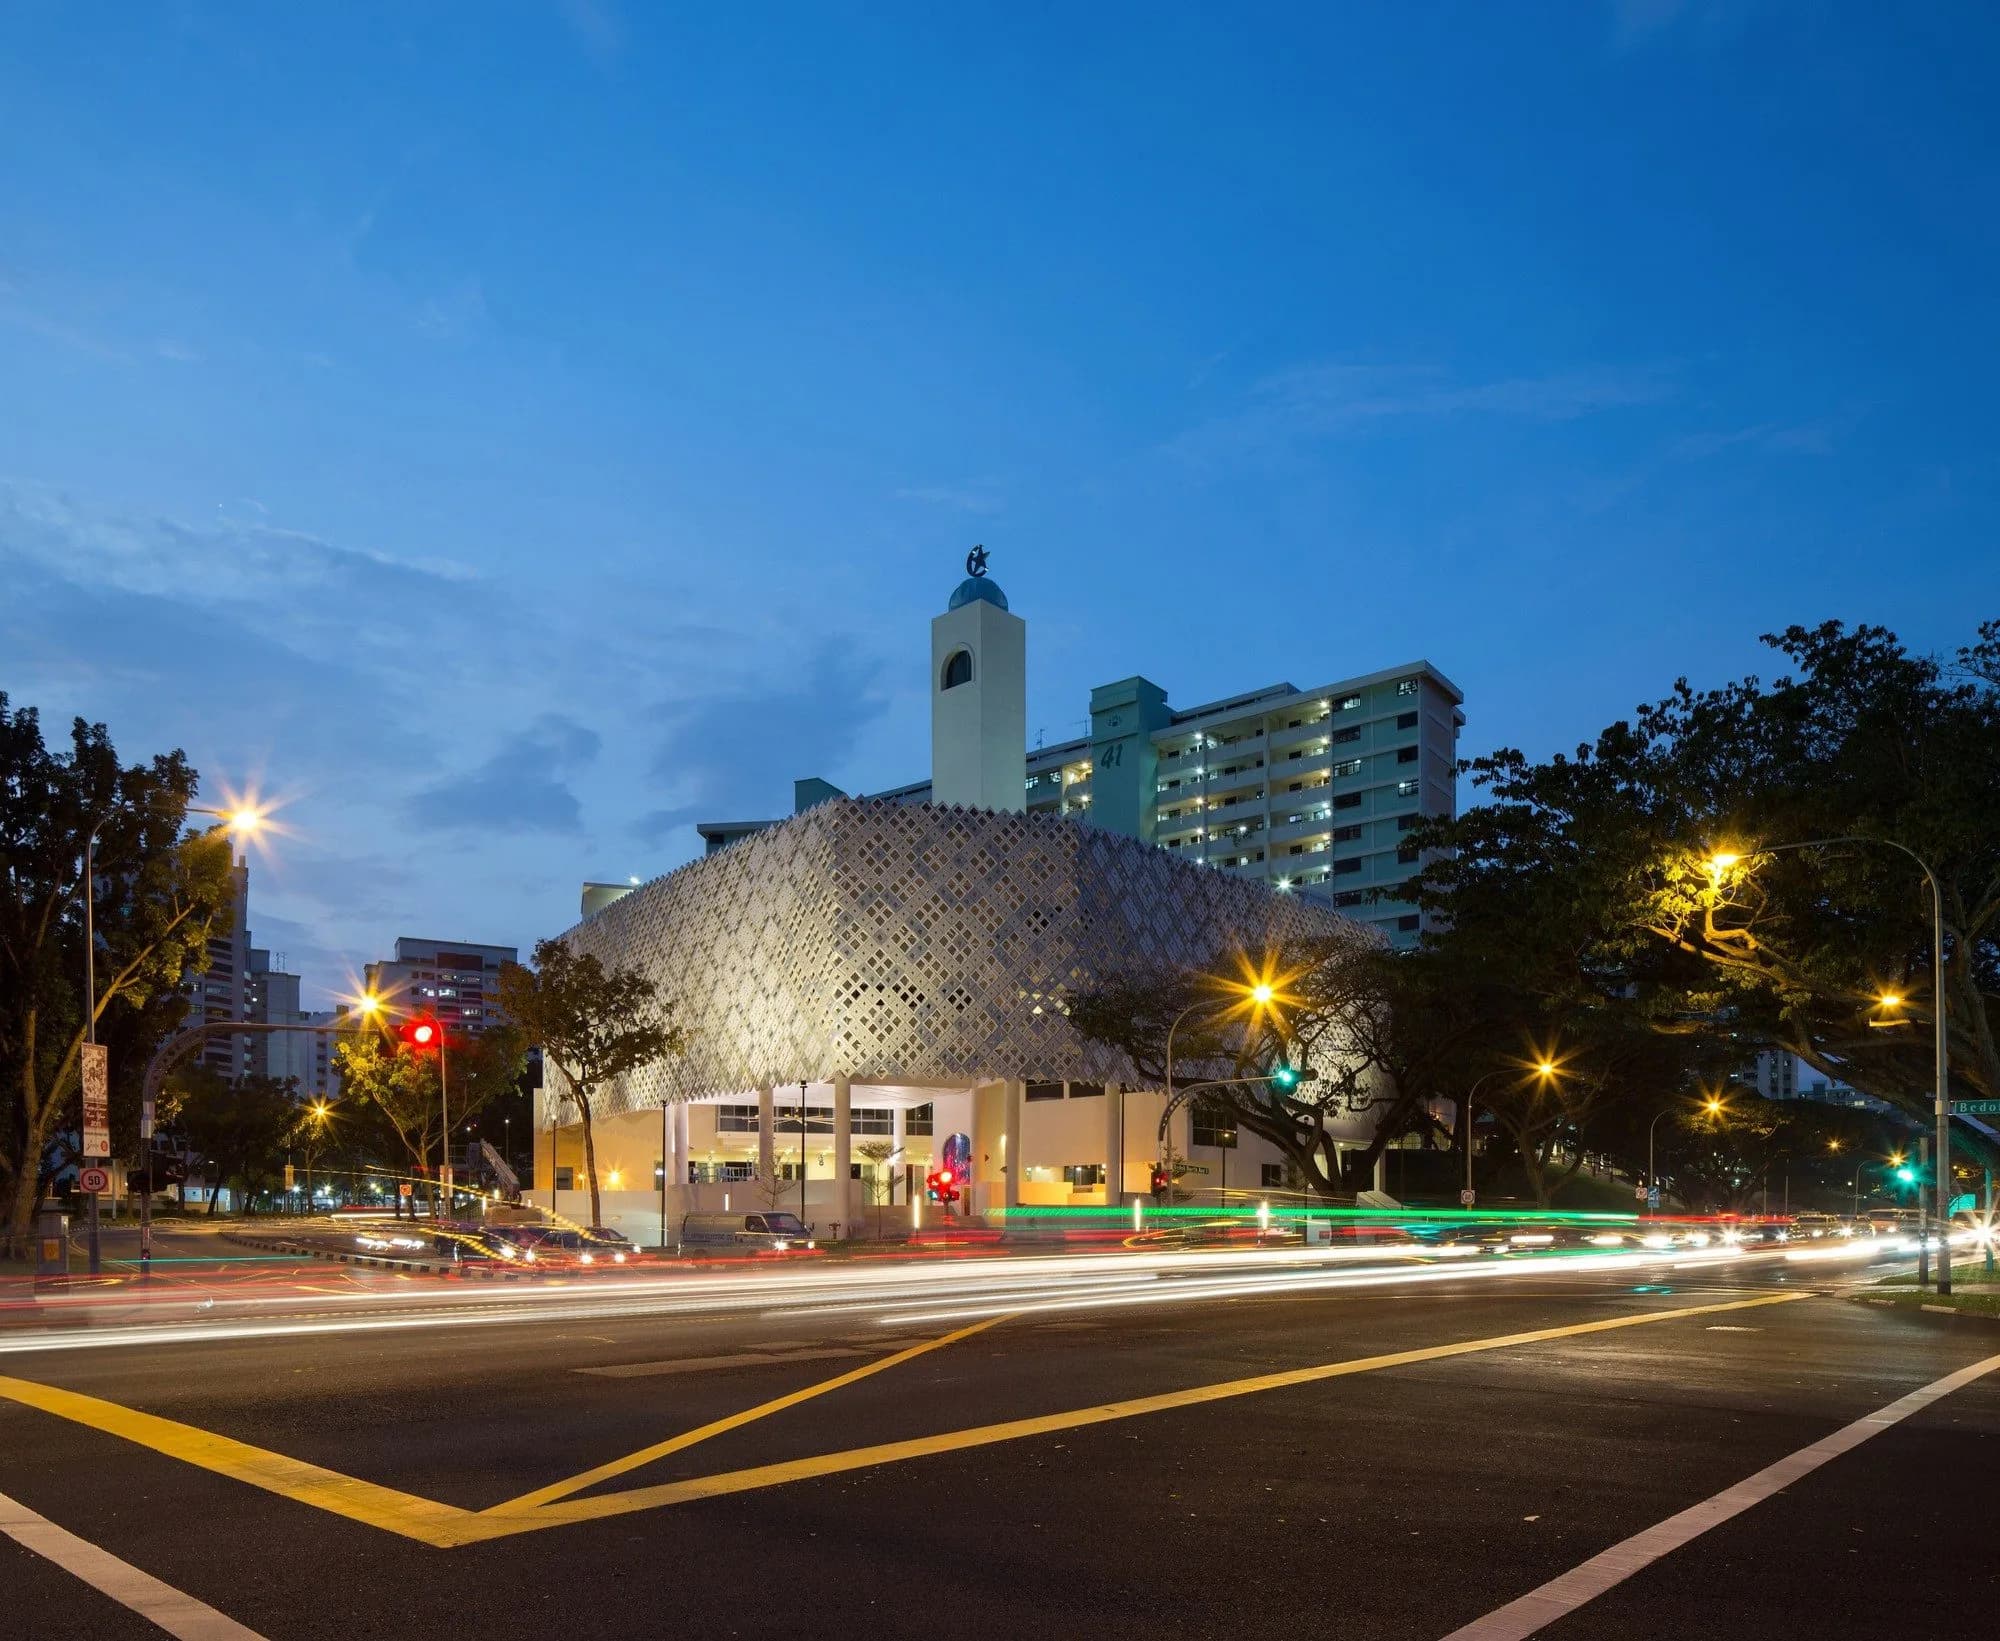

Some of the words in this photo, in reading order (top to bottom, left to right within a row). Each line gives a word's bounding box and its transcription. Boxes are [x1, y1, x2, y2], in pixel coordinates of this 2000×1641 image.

[1101, 743, 1123, 769] 41
[1960, 1102, 2000, 1112] Bedo
[88, 1175, 101, 1185] 50
